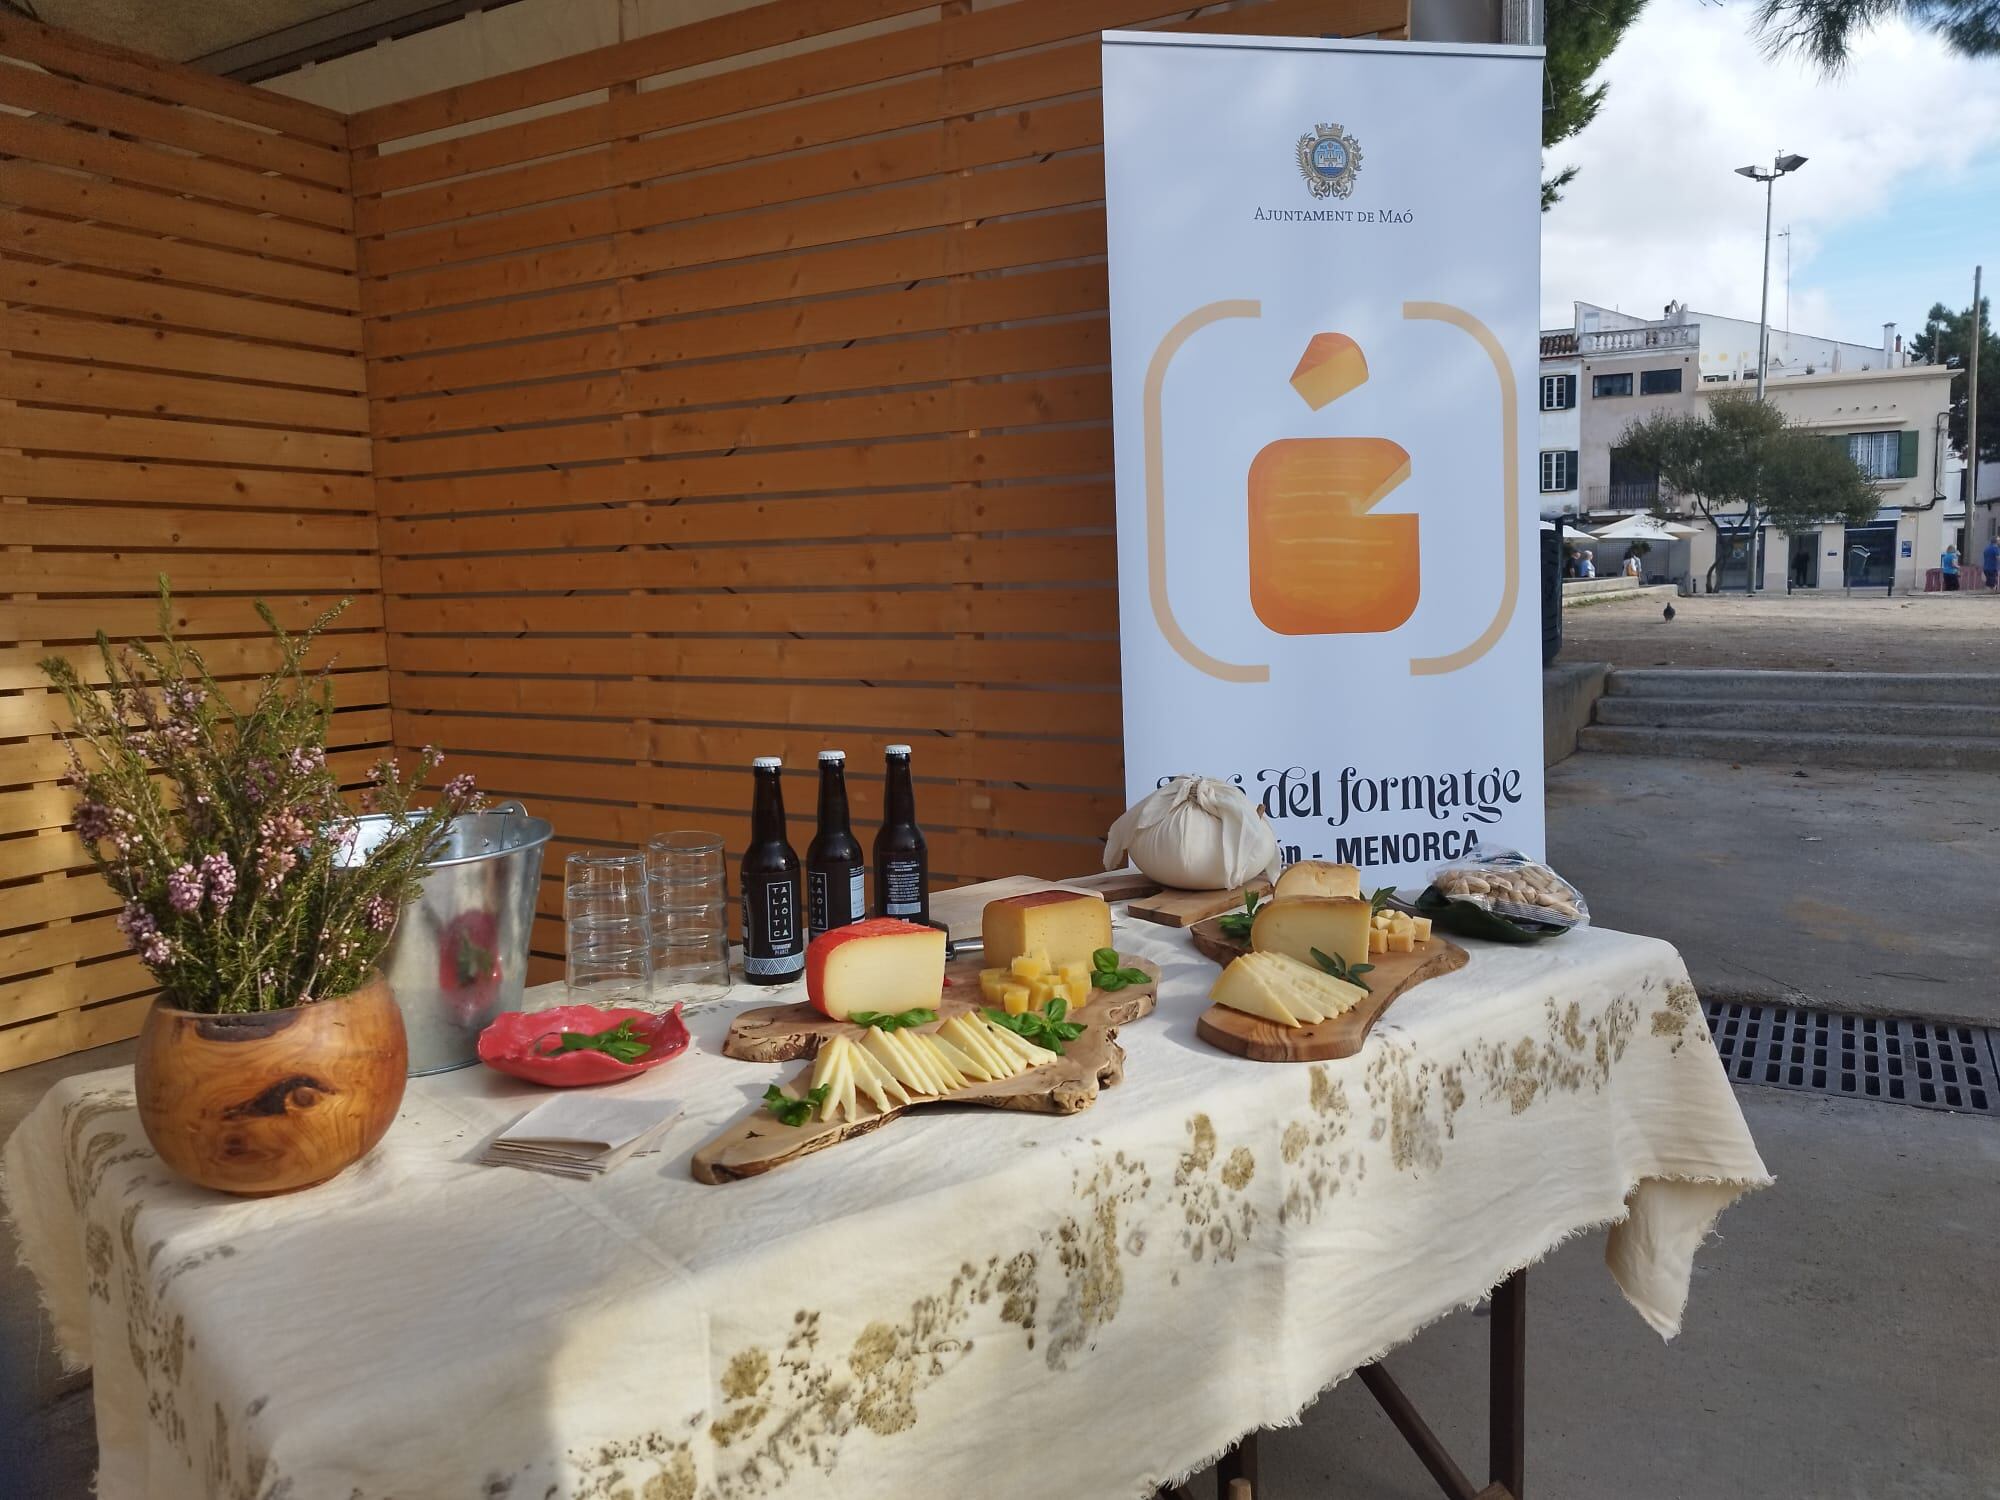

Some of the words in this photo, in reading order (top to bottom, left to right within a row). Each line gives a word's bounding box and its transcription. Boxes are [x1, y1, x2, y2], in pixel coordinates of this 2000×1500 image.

[1256, 766, 1324, 819] del
[1327, 766, 1522, 827] formatge
[1336, 829, 1479, 867] MENORCA
